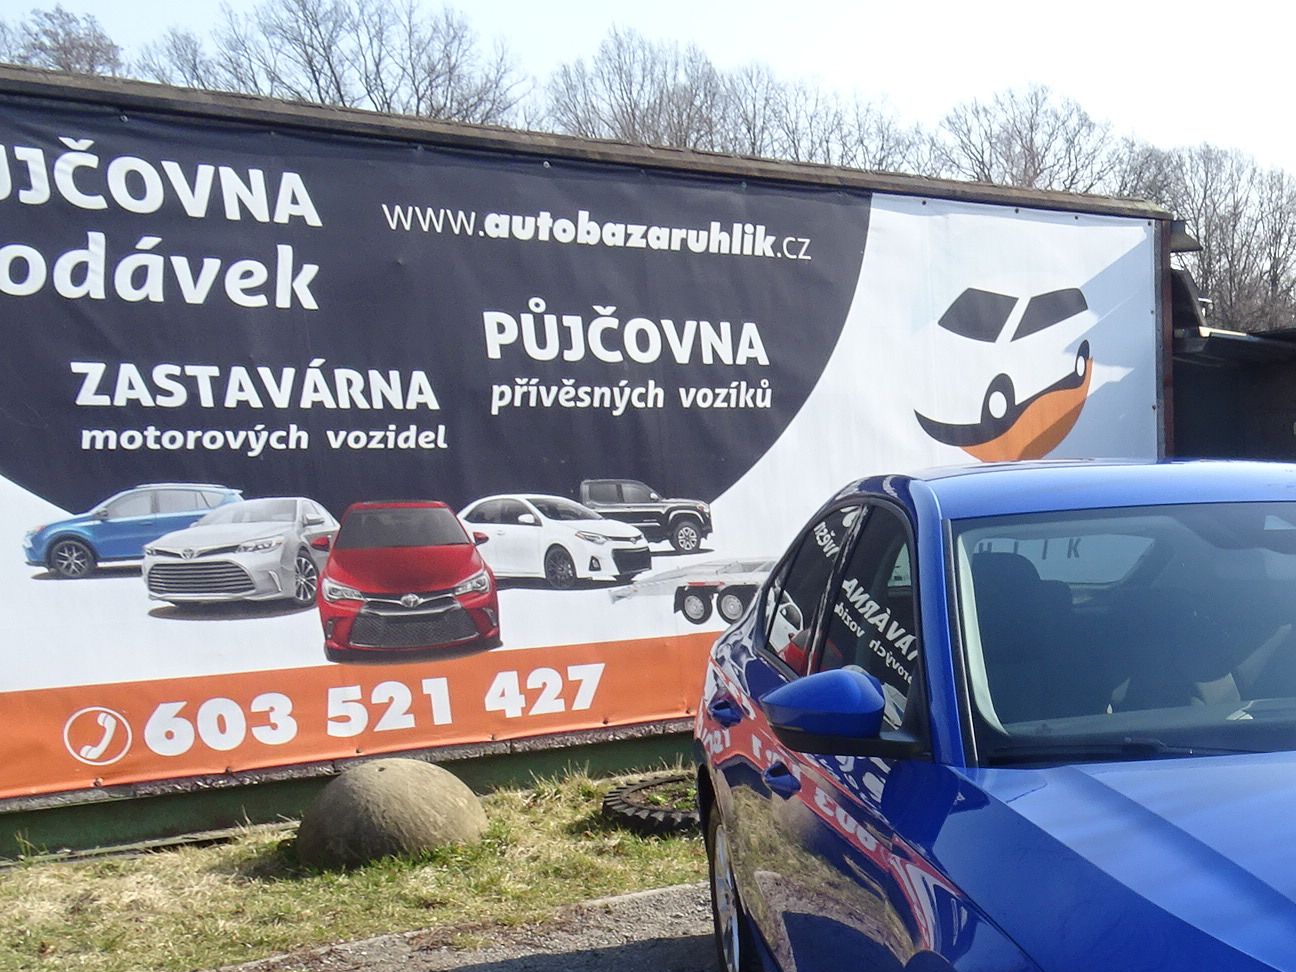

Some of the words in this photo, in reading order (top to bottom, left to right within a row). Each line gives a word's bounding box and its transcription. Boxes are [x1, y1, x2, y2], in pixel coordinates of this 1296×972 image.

[382, 204, 812, 260] www.autobazaruhlik.cz
[483, 297, 770, 366] PŮJČOVNA
[71, 359, 440, 410] ZASTAVÁRNA
[491, 378, 664, 416] přívěsných
[679, 379, 772, 408] vozíků
[82, 424, 309, 457] motorových
[327, 425, 449, 449] vozidel
[143, 693, 298, 757] 603
[328, 678, 453, 738] 521
[485, 663, 606, 718] 427
